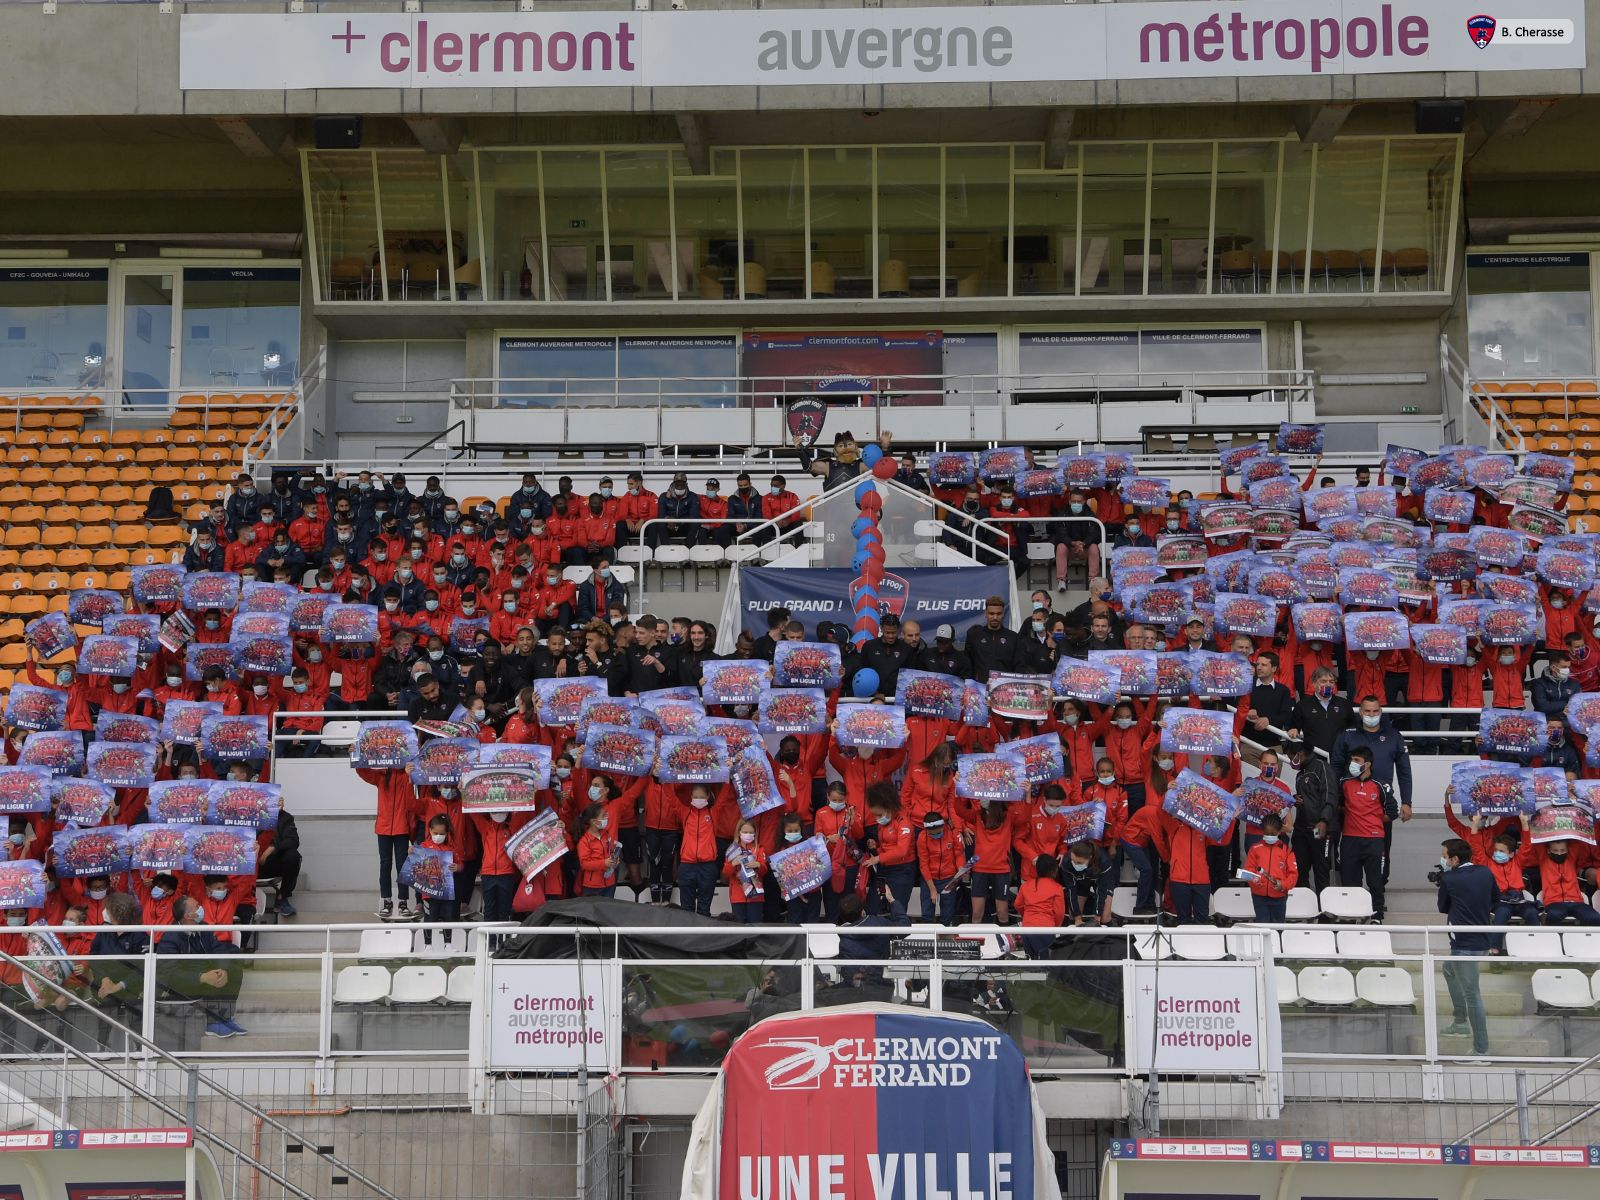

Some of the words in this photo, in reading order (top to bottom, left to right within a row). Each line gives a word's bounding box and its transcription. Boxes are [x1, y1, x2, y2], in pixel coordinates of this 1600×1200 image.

[380, 21, 634, 72] clermont
[757, 24, 1013, 72] auvergne
[1139, 3, 1429, 73] métropole
[808, 337, 879, 345] clermontfoot.com
[791, 400, 811, 410] CLERMONT
[811, 401, 822, 409] FOOT
[887, 579, 903, 591] FOOT
[749, 601, 780, 612] PLUS
[783, 600, 835, 611] GRAND
[837, 600, 843, 611] !
[916, 601, 949, 611] PLUS
[1185, 815, 1202, 827] LIGUE
[800, 881, 815, 891] LIGUE
[514, 994, 594, 1011] clermont
[1158, 996, 1241, 1013] clermont
[508, 1013, 588, 1028] auvergne
[1157, 1016, 1235, 1030] auvergne
[515, 1028, 603, 1048] métropole
[1161, 1030, 1252, 1051] métropole
[833, 1036, 1001, 1062] CLERMONT
[833, 1064, 971, 1087] FERRAND
[739, 1154, 845, 1200] UNE
[867, 1153, 1012, 1200] VILLE
